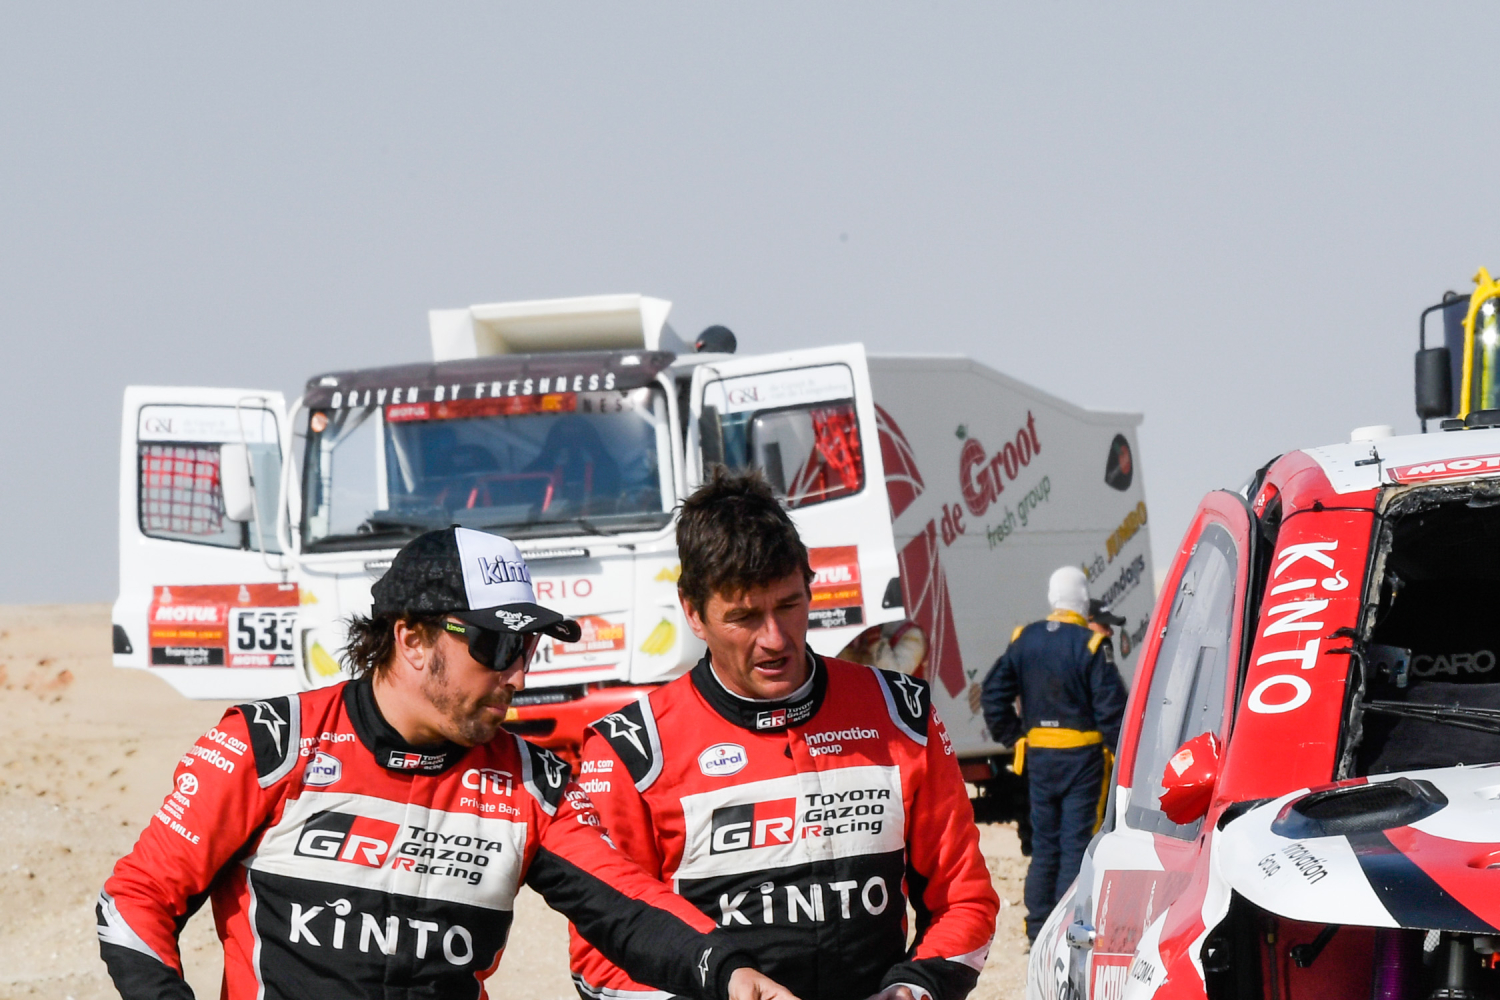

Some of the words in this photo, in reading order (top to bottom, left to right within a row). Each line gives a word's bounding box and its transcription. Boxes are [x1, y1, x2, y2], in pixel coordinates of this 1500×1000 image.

[331, 387, 418, 407] DRIVEN
[434, 385, 461, 402] BY
[475, 372, 616, 399] FRESHNESS
[941, 503, 967, 547] de
[959, 410, 1042, 517] Groot
[986, 505, 1016, 551] fresh
[1018, 475, 1051, 527] group
[155, 606, 218, 622] MOTUL
[237, 612, 298, 651] 533
[446, 623, 466, 634] kimoa
[1410, 650, 1496, 678] CARO
[758, 713, 786, 727] GR
[804, 727, 879, 745] Innovation
[704, 751, 743, 770] eurol
[809, 742, 843, 758] Group
[389, 757, 419, 768] GR
[460, 797, 496, 813] Private
[804, 788, 891, 807] TOYOTA
[802, 804, 885, 824] GAZOO
[170, 821, 200, 845] MILLE
[407, 825, 503, 854] TOYOTA
[712, 815, 794, 853] GR
[800, 819, 883, 840] Racing
[298, 829, 390, 868] GR
[400, 843, 490, 868] GAZOO
[392, 856, 483, 886] Racing
[1258, 853, 1281, 880] Group
[1281, 840, 1328, 885] Innovation
